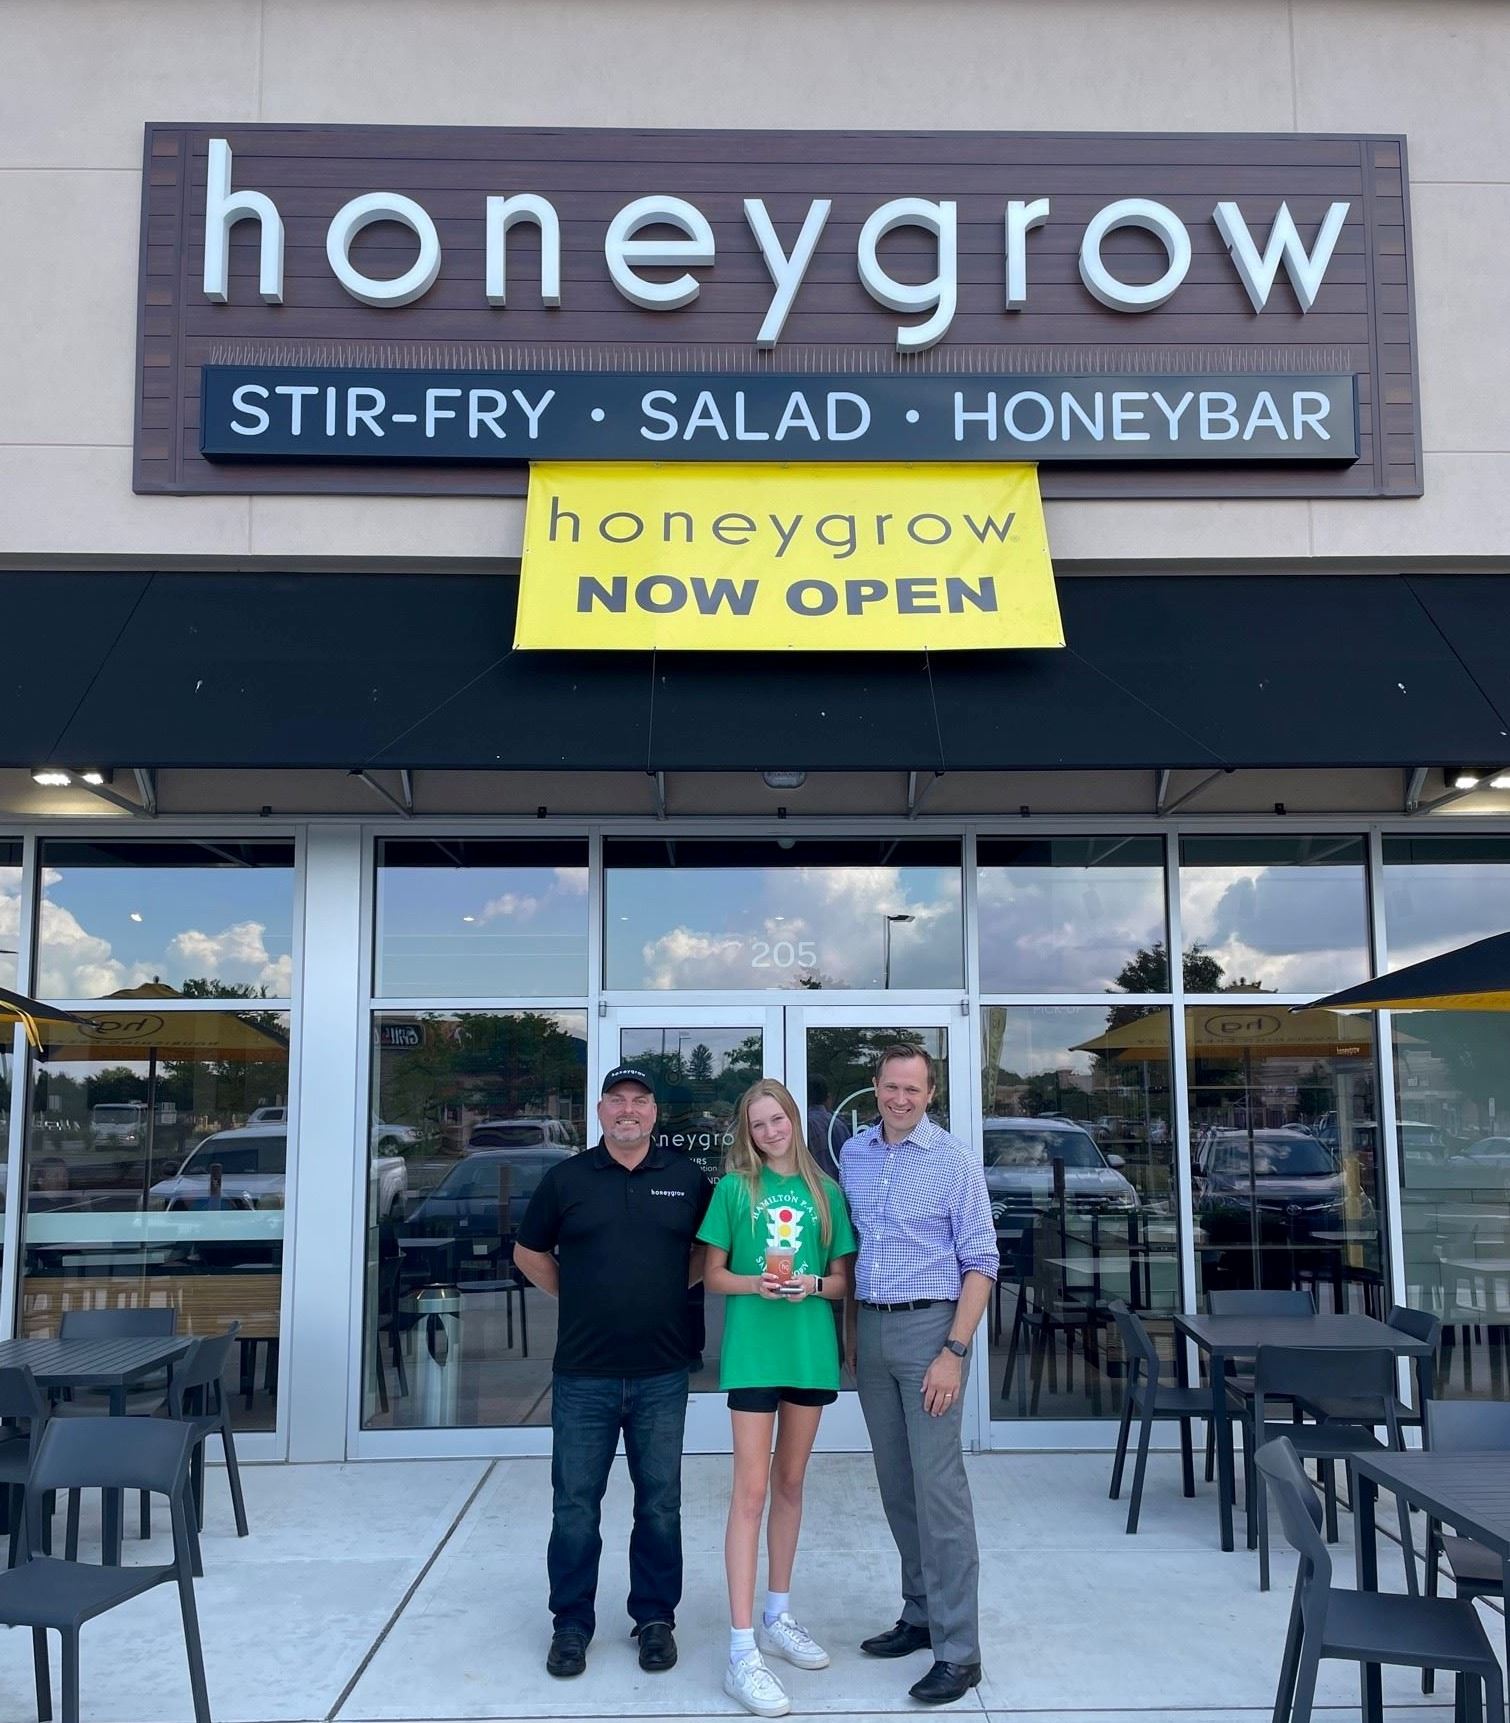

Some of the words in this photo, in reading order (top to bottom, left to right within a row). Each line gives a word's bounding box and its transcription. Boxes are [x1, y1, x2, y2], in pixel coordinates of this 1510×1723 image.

[203, 138, 1350, 353] honeygrow
[229, 384, 556, 441] STIR-FRY
[640, 390, 872, 442] SALAD
[953, 390, 1331, 442] HONEYBAR
[548, 496, 1017, 559] honeygrow
[576, 575, 760, 616] NOW
[785, 575, 999, 617] OPEN
[751, 941, 817, 968] 205
[650, 1188, 685, 1198] honeygrow
